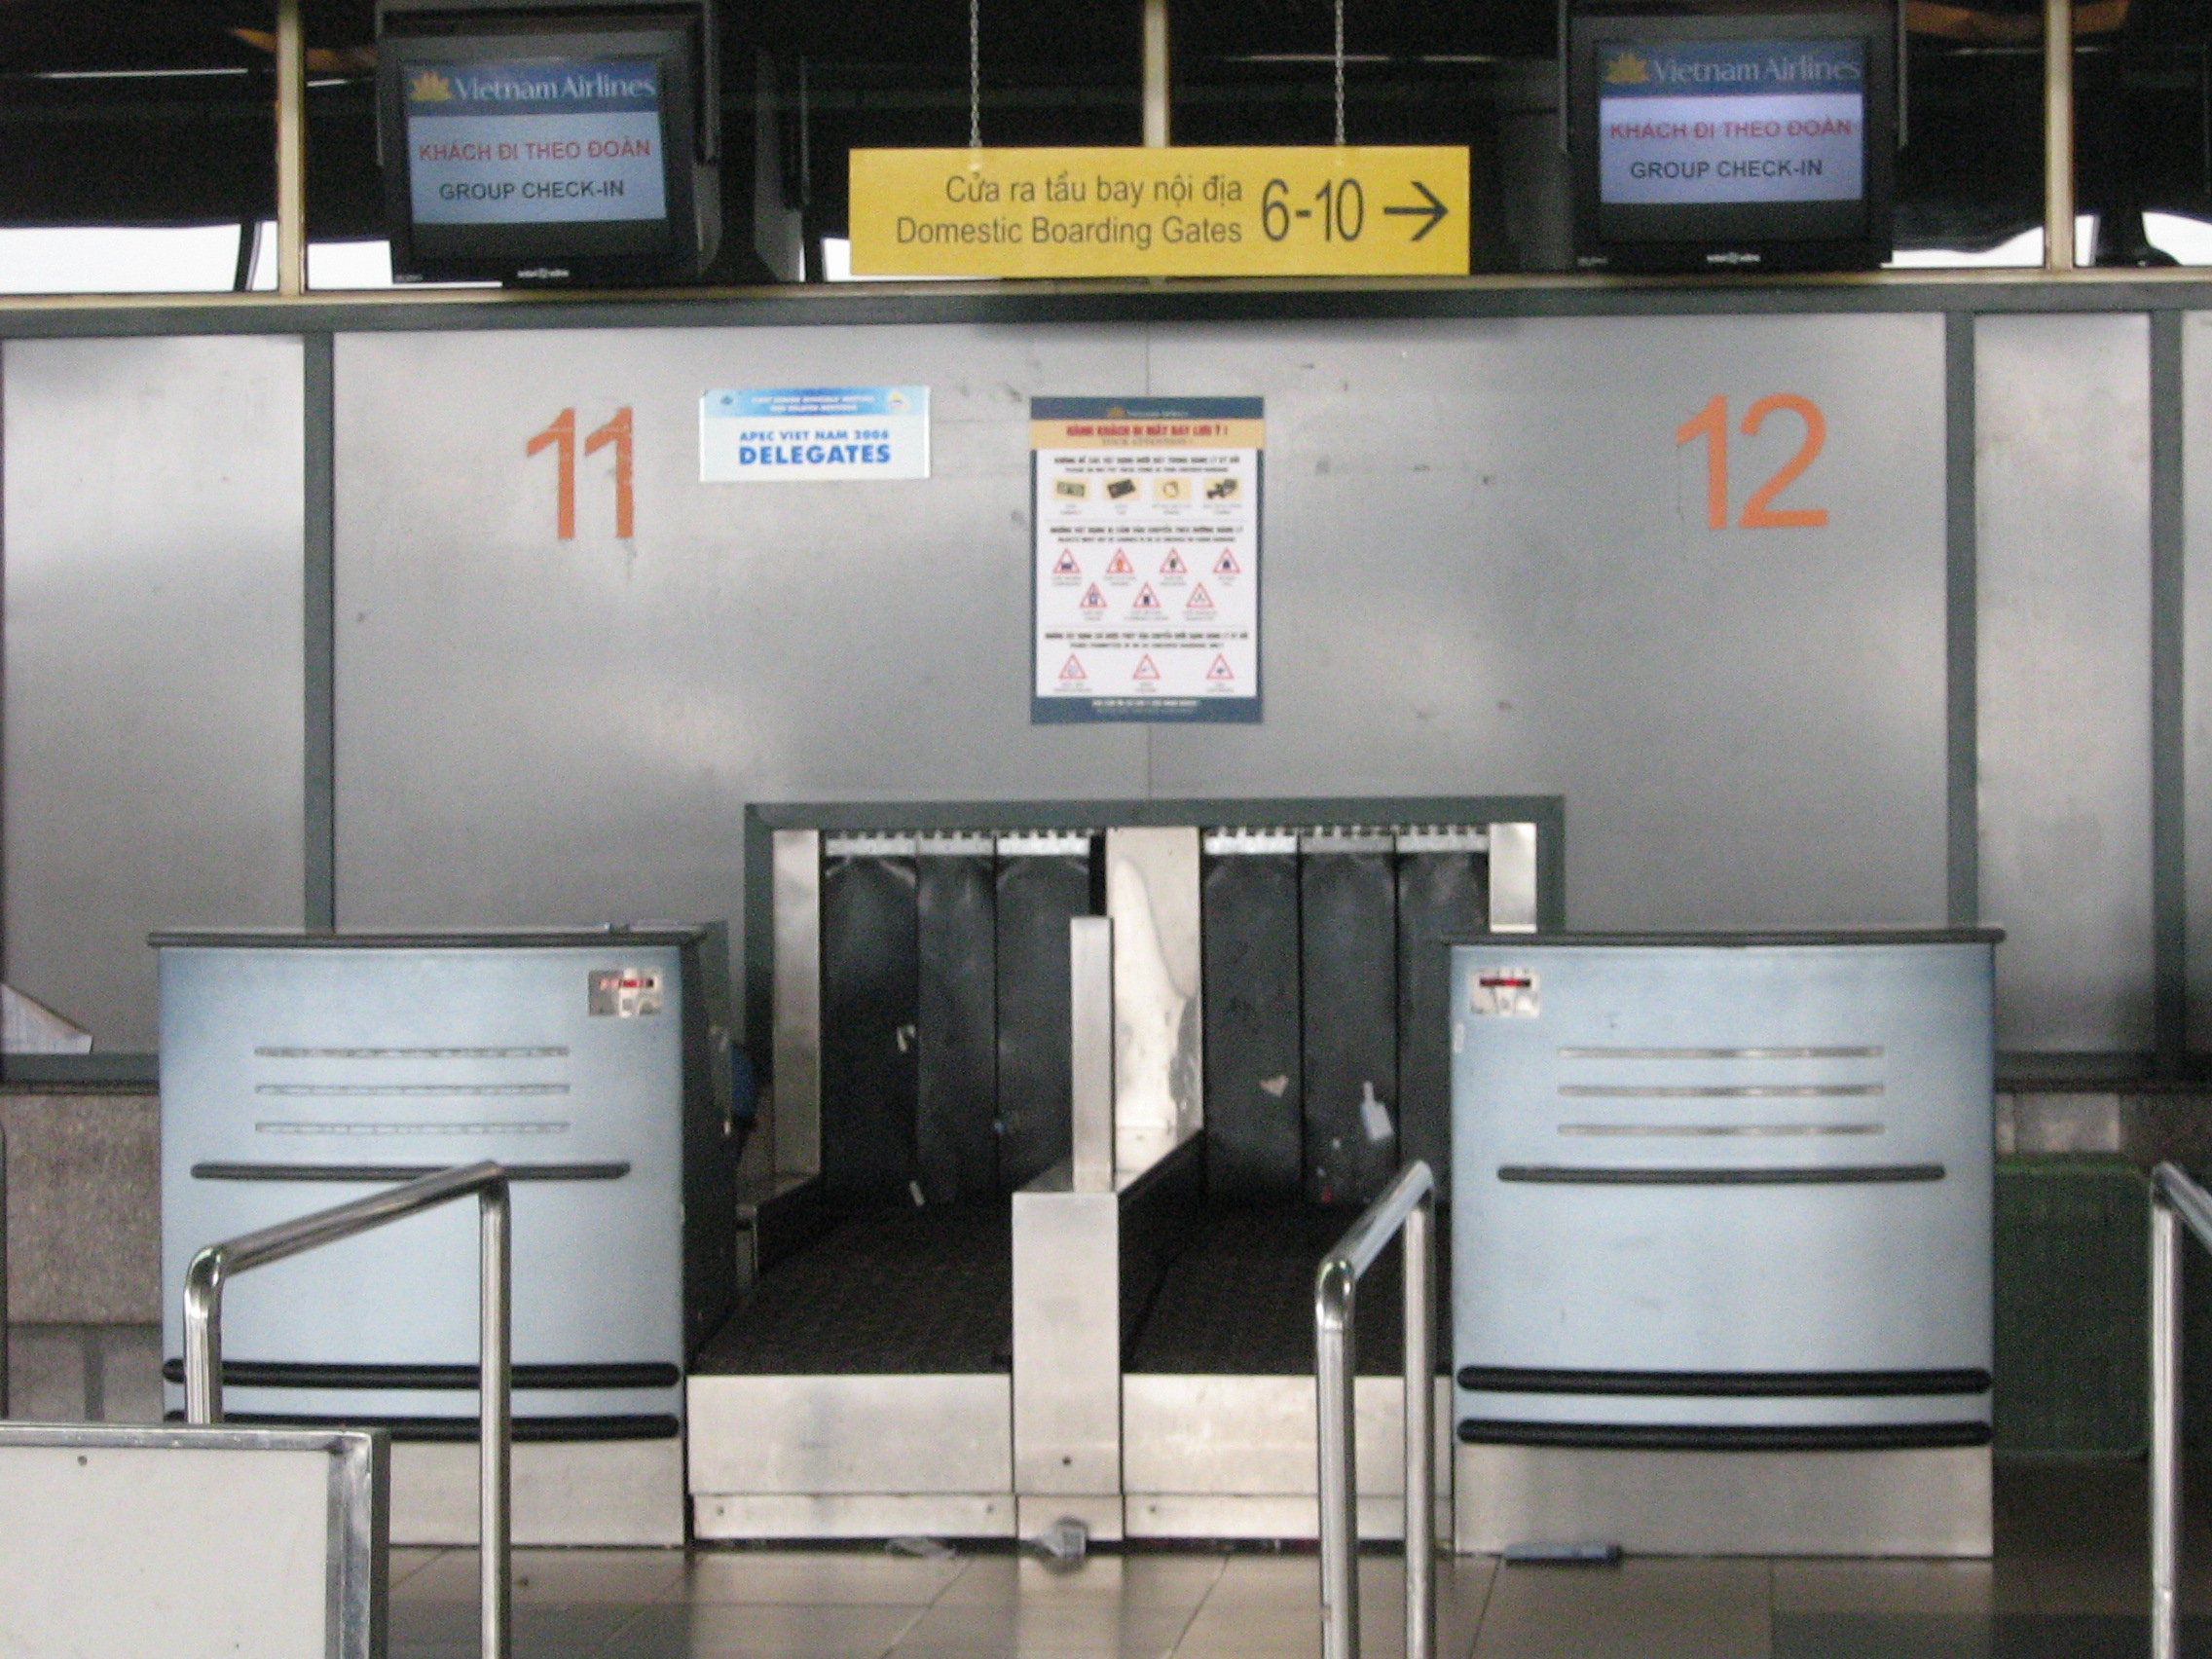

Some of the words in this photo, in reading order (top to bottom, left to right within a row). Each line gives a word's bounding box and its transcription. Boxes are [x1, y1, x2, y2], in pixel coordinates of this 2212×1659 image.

[1652, 55, 1759, 82] Vietnam
[1765, 52, 1862, 81] Airlines
[454, 76, 558, 99] Vietnam
[560, 71, 657, 98] Airlines
[1724, 121, 1781, 137] THEO
[527, 141, 581, 160] THEO
[1630, 161, 1711, 178] GROUP
[1716, 159, 1824, 177] CHECK-IN
[440, 182, 515, 201] GROUP
[522, 179, 624, 199] CHECK-IN
[945, 171, 1000, 203] Cửa
[1010, 182, 1035, 202] ra
[1096, 175, 1143, 207] bay
[1154, 174, 1193, 206] nội
[1202, 175, 1242, 206] địa
[1262, 177, 1364, 241] 6-10
[897, 216, 1022, 243] Domestic
[1032, 216, 1152, 250] Boarding
[1162, 215, 1242, 243] Gates
[740, 431, 773, 441] APEC
[815, 429, 847, 440] NAM
[739, 444, 891, 465] DELEGATES
[1675, 393, 1828, 530] 12
[526, 407, 634, 540] 11
